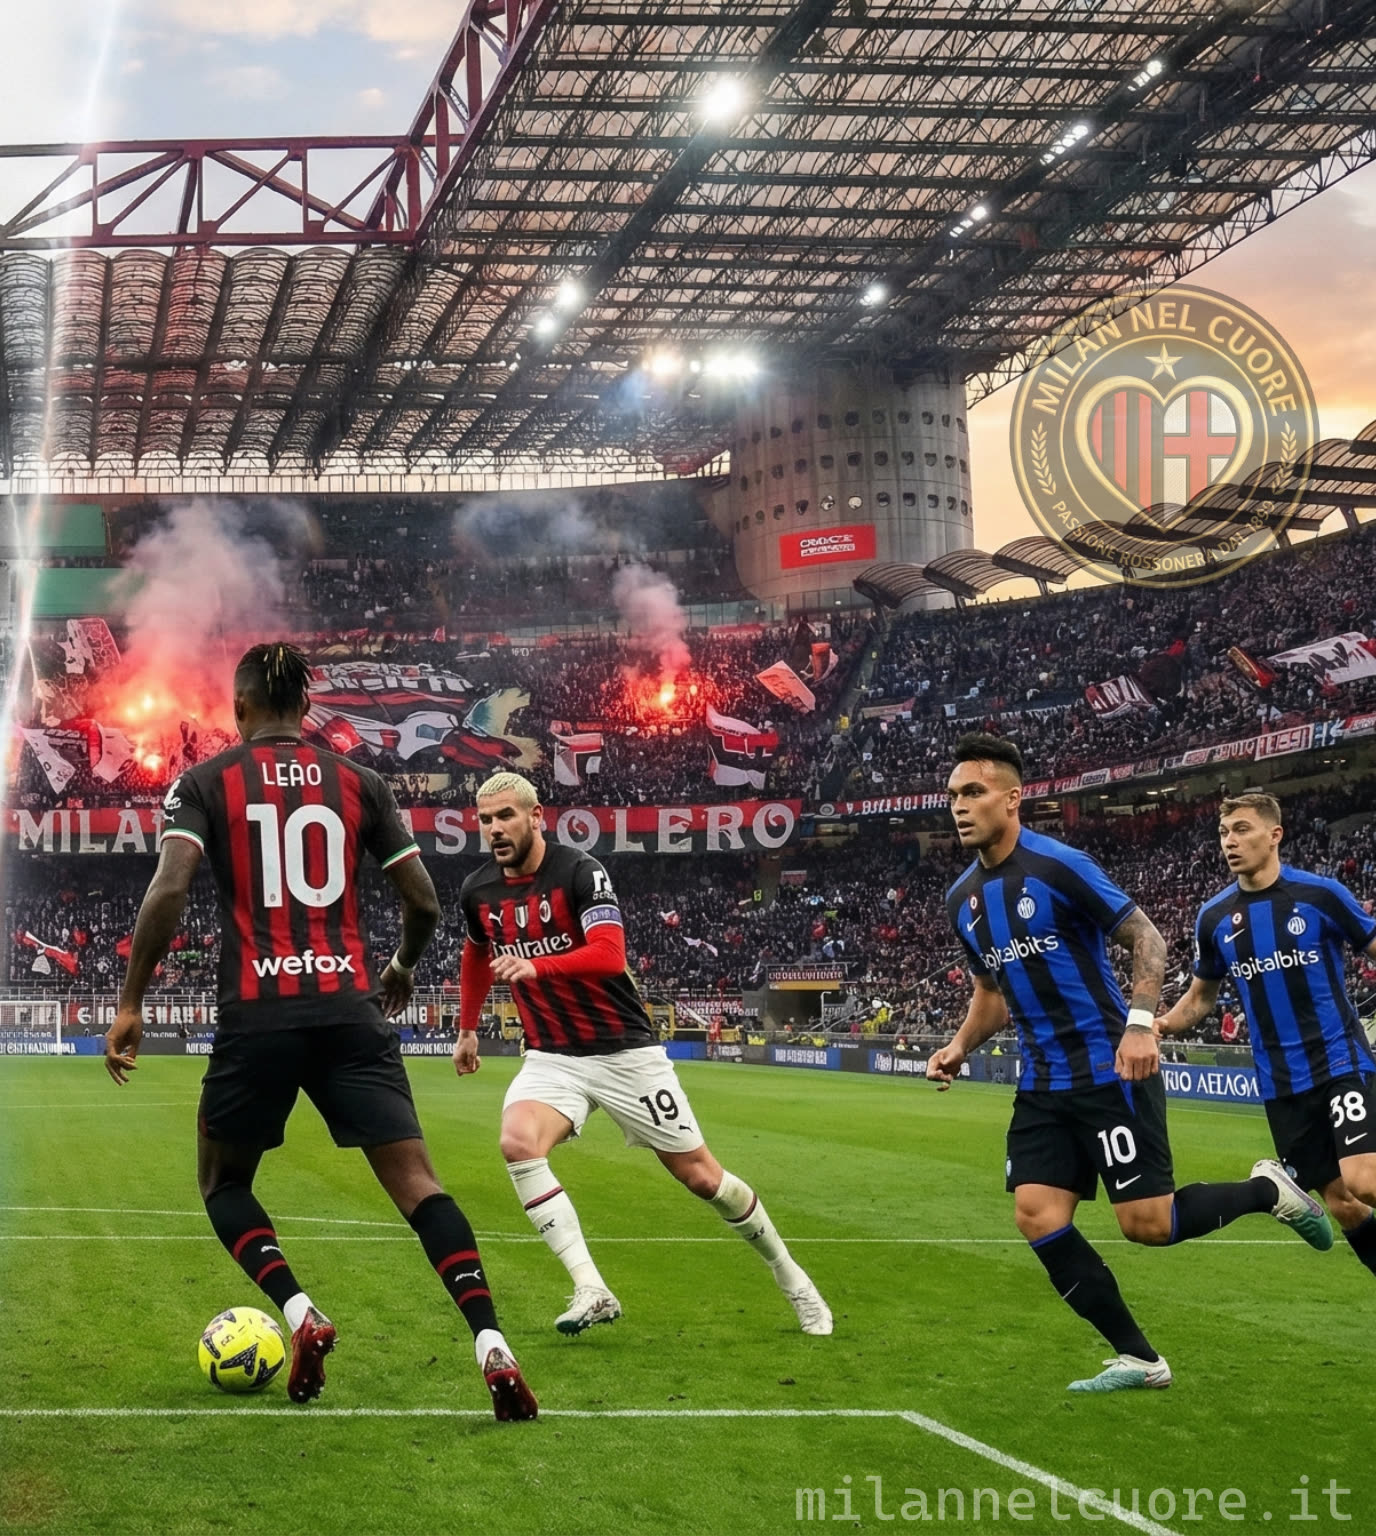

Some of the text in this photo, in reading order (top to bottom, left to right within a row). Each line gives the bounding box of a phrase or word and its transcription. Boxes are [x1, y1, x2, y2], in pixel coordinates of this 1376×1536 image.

[246, 803, 346, 908] 10
[252, 950, 355, 978] wefox
[639, 1089, 679, 1126] 19
[1329, 1091, 1367, 1128] 38
[1097, 1125, 1137, 1168] 10
